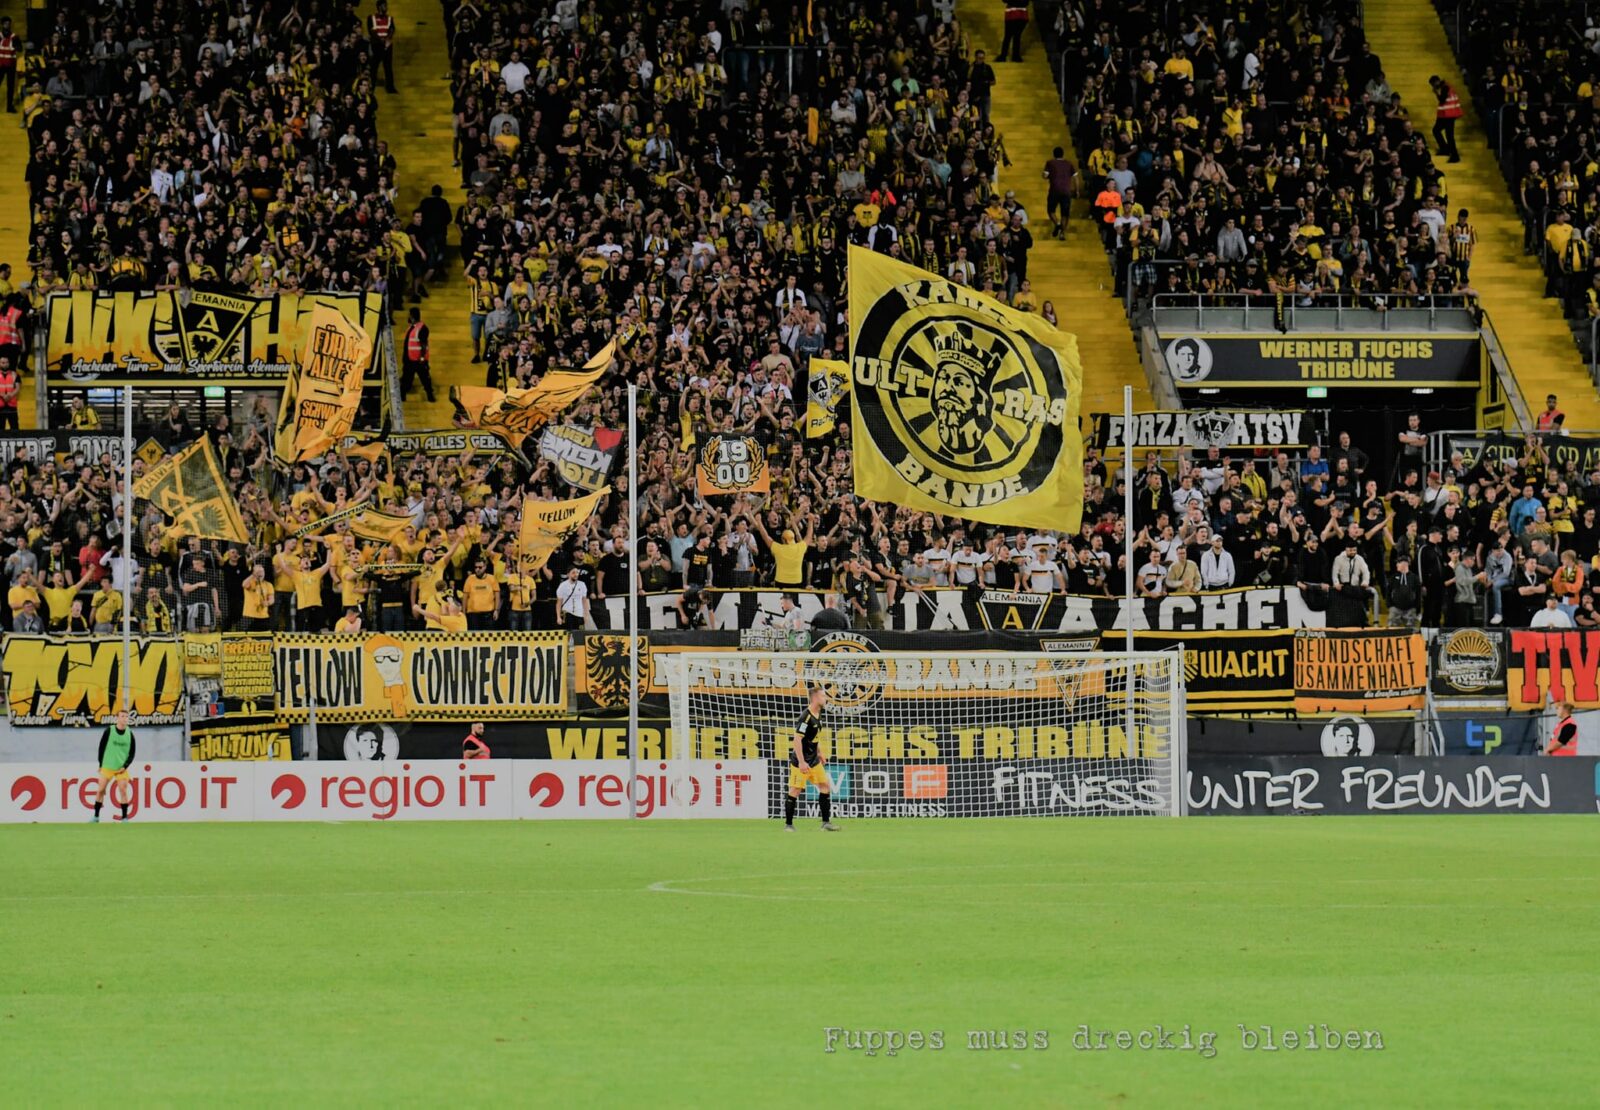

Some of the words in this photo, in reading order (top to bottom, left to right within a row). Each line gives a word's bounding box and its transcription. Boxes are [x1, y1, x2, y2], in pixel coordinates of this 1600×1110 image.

[72, 358, 118, 374] Aachener
[164, 362, 183, 374] und
[186, 357, 244, 374] Sportverein
[1259, 341, 1354, 359] WERNER
[1359, 340, 1433, 359] FUCHS
[1297, 359, 1396, 379] TRIBÜNE
[425, 435, 465, 450] ALLES
[1106, 413, 1188, 447] FORZA
[1232, 412, 1301, 446] ATSV
[895, 453, 1030, 508] BANDE
[981, 591, 1042, 605] ALEMANNIA
[1047, 640, 1093, 651] ALEMANNIA
[275, 646, 362, 708] YELLOW
[411, 646, 563, 706] CONNECTION
[894, 656, 1038, 691] BANDE
[1200, 649, 1289, 679] WACHT
[1295, 661, 1415, 690] USAMMENHALT
[546, 727, 759, 760] WERNER
[951, 720, 1169, 759] TRIBÜNE
[1465, 719, 1502, 755] tp
[61, 764, 186, 820] regio
[321, 763, 446, 819] regio
[579, 762, 702, 818] regio
[992, 766, 1166, 810] FITNESS
[1187, 768, 1324, 810] UNTER
[1340, 765, 1551, 811] FREUNDEN
[806, 803, 859, 818] WRLD
[863, 803, 884, 818] OF
[887, 803, 946, 818] FITNESS
